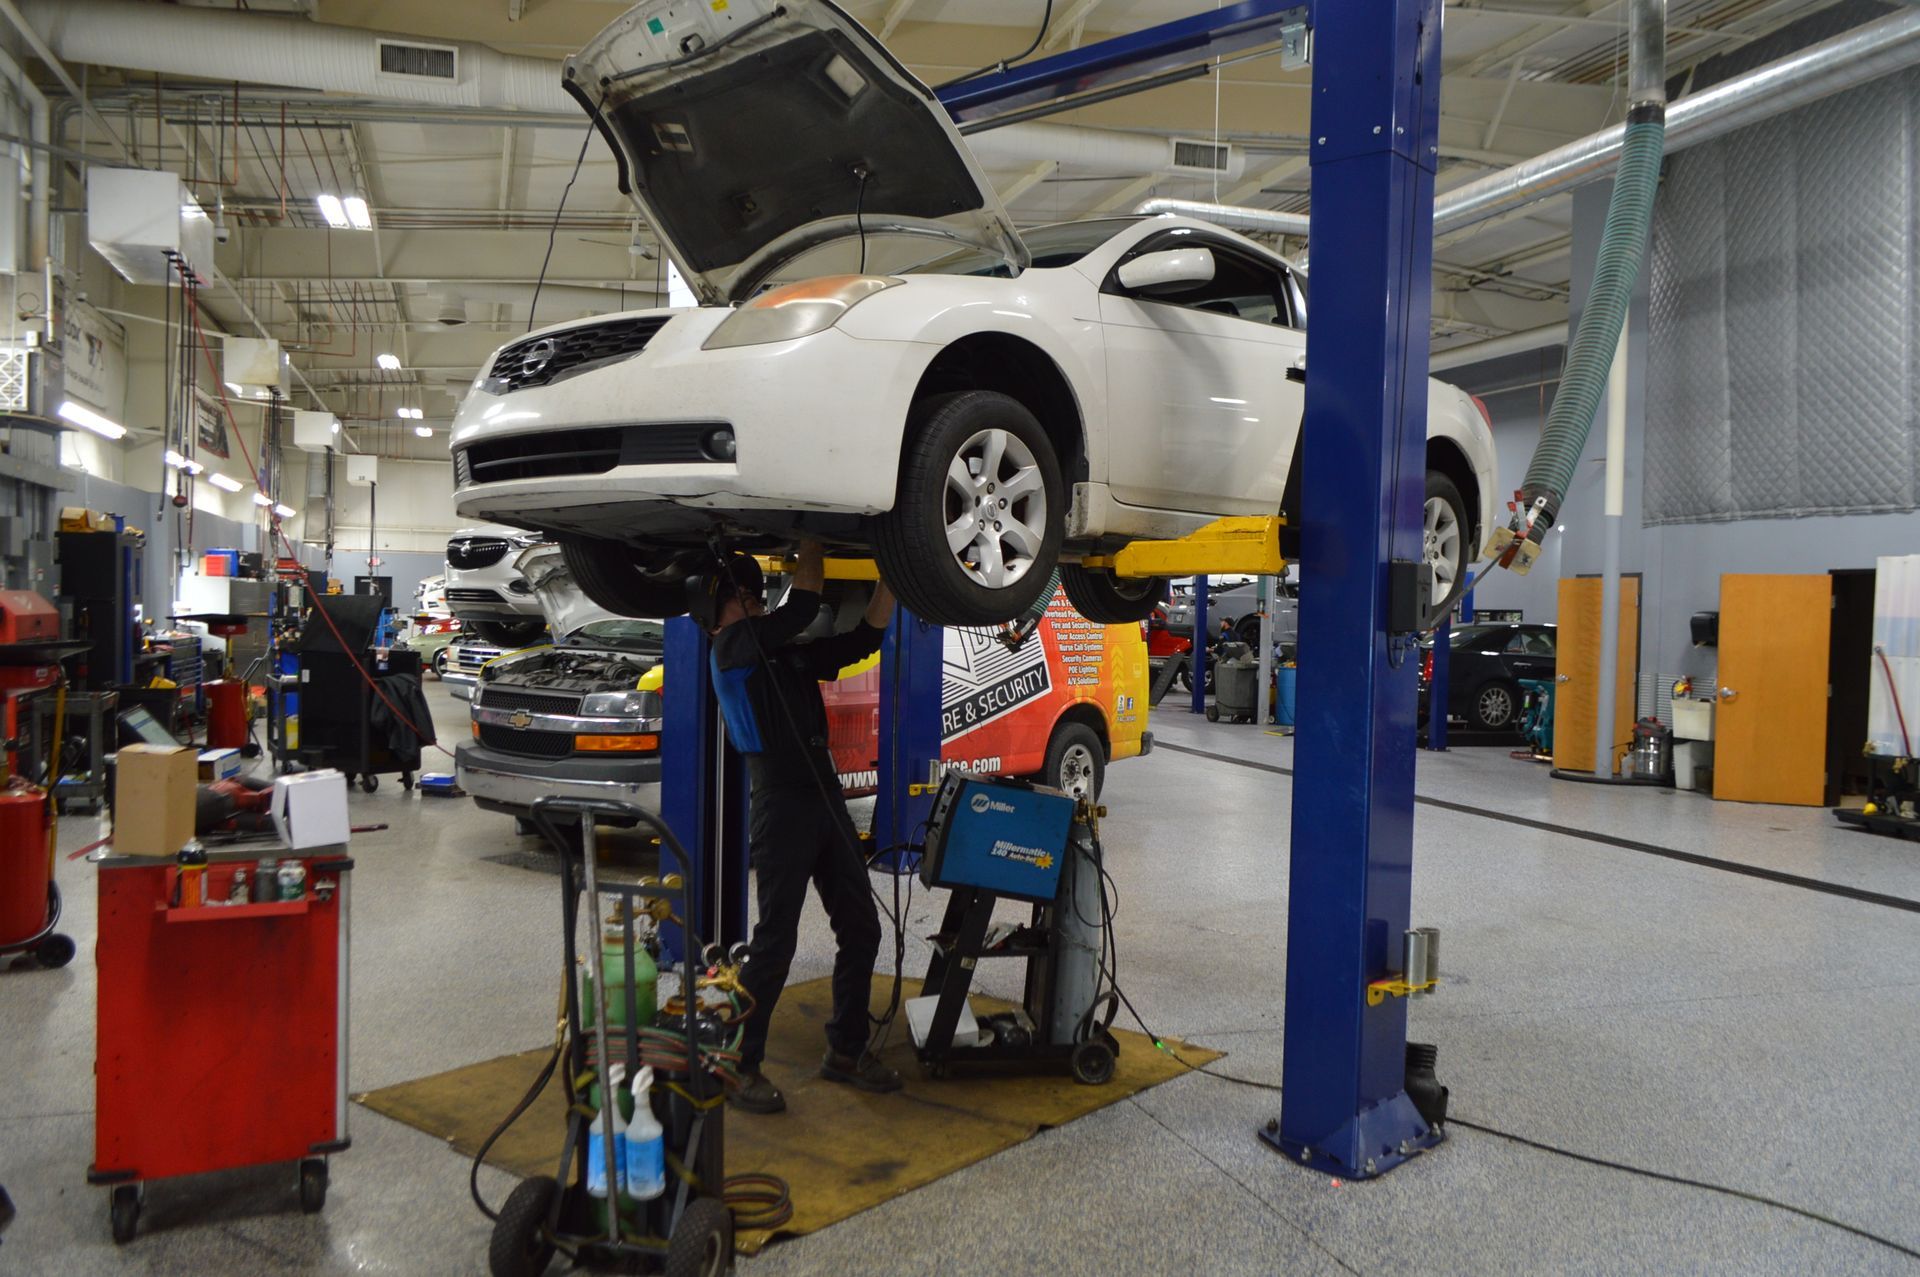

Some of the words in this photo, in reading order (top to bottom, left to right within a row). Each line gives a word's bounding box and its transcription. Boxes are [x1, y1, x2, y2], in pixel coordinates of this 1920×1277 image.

[1051, 621, 1061, 629] Fire
[1062, 621, 1071, 629] and
[1072, 621, 1091, 630] Security
[1057, 632, 1068, 640] Door
[1069, 632, 1086, 640] Access
[1087, 632, 1103, 640] Control
[1084, 644, 1103, 652] Systems
[1062, 655, 1081, 663] Security
[1079, 666, 1097, 674] Lighting
[1077, 677, 1099, 685] Solutions
[941, 707, 963, 734] RE
[965, 701, 977, 723] &
[978, 666, 1043, 716] SECURITY
[990, 801, 1016, 813] Miller
[990, 847, 1008, 857] 140
[994, 839, 1046, 857] Millermatic
